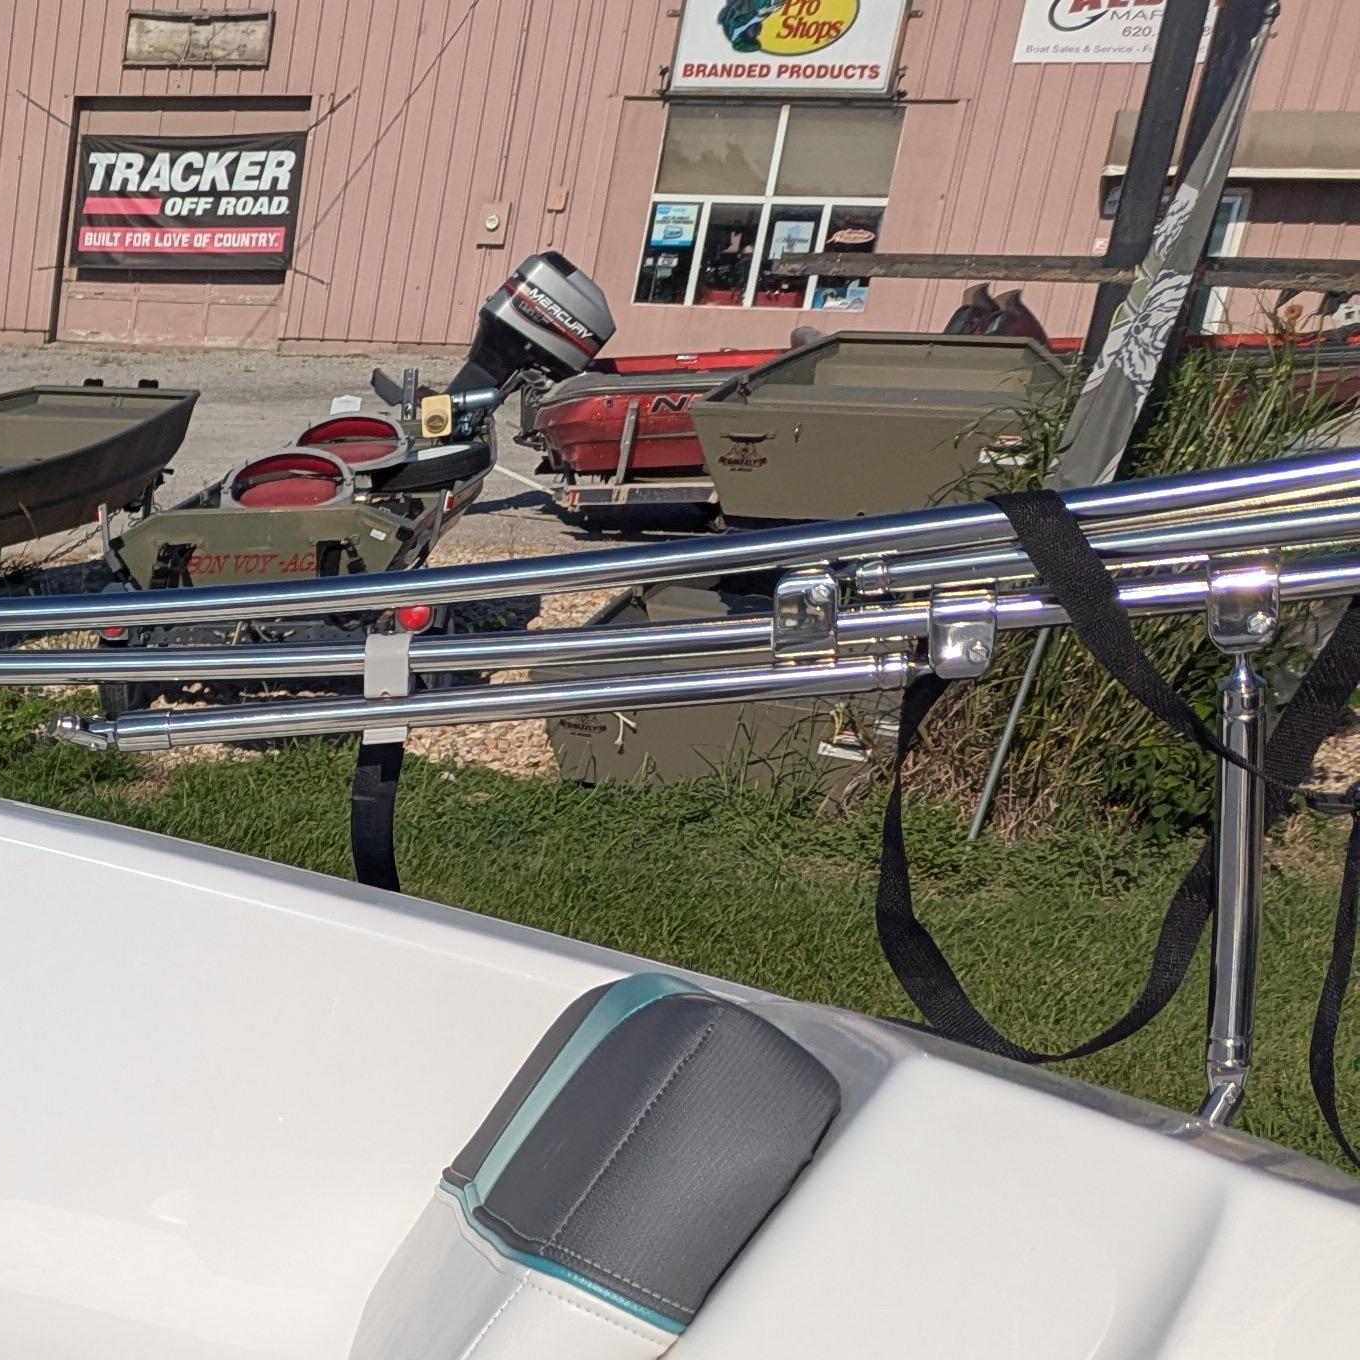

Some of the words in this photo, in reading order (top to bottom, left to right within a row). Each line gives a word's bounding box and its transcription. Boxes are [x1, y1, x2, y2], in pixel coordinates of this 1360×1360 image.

[776, 16, 843, 44] Shops
[1025, 45, 1049, 54] Boat
[1053, 45, 1080, 54] Sales
[1094, 45, 1131, 54] Service
[682, 63, 771, 79] BRANDED
[776, 64, 880, 80] PRODUCTS
[88, 150, 296, 193] TRACKER
[164, 197, 215, 216] OFF
[217, 196, 288, 216] ROAD
[84, 232, 120, 247] BUILT
[125, 232, 150, 247] FOR
[154, 232, 189, 248] LOVE
[194, 232, 210, 248] OF
[529, 288, 593, 338] MERCURY
